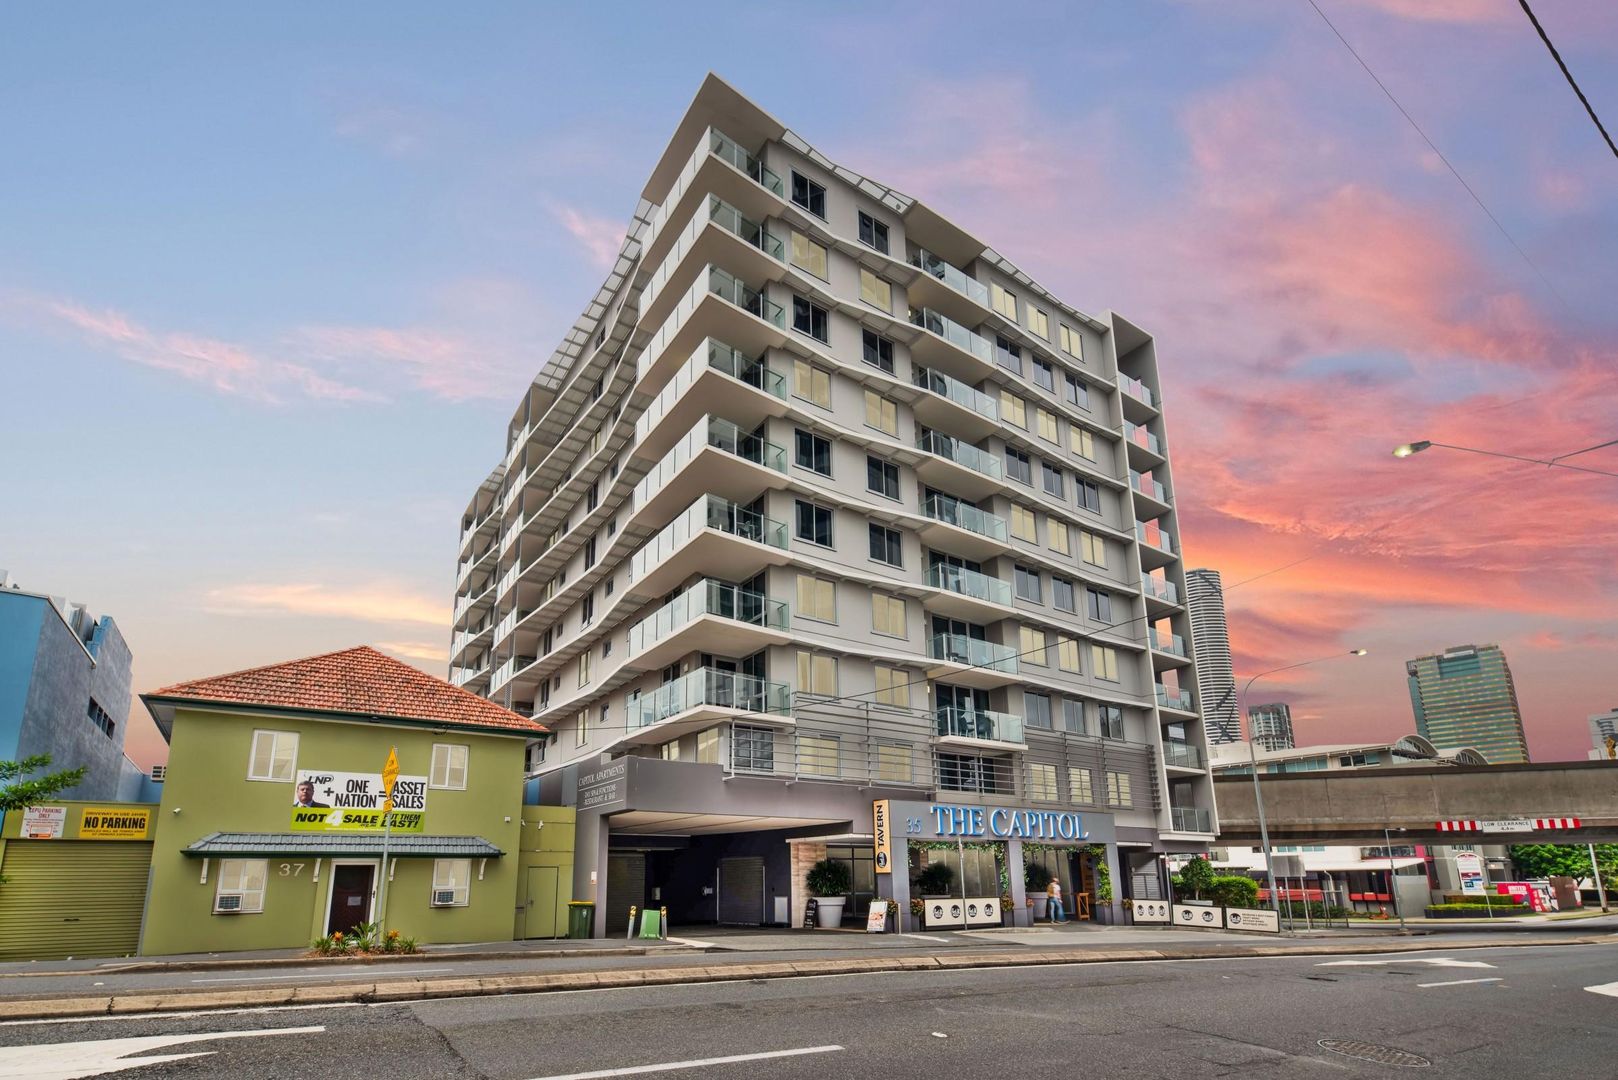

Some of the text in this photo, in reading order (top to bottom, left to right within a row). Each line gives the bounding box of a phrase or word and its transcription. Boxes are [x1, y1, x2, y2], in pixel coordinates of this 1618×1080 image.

[308, 775, 333, 785] LNP
[346, 779, 370, 794] ONE
[392, 781, 426, 796] ASSET
[334, 793, 378, 808] NATION
[392, 794, 425, 809] SALES
[84, 816, 147, 830] NO PARKING
[295, 809, 379, 827] NOT 4 SALE
[380, 819, 419, 829] LAST!
[400, 814, 422, 822] THEM
[906, 817, 922, 834] 35
[930, 805, 1090, 840] THE CAPITOL
[876, 804, 885, 849] TAVERN
[279, 863, 305, 877] 37
